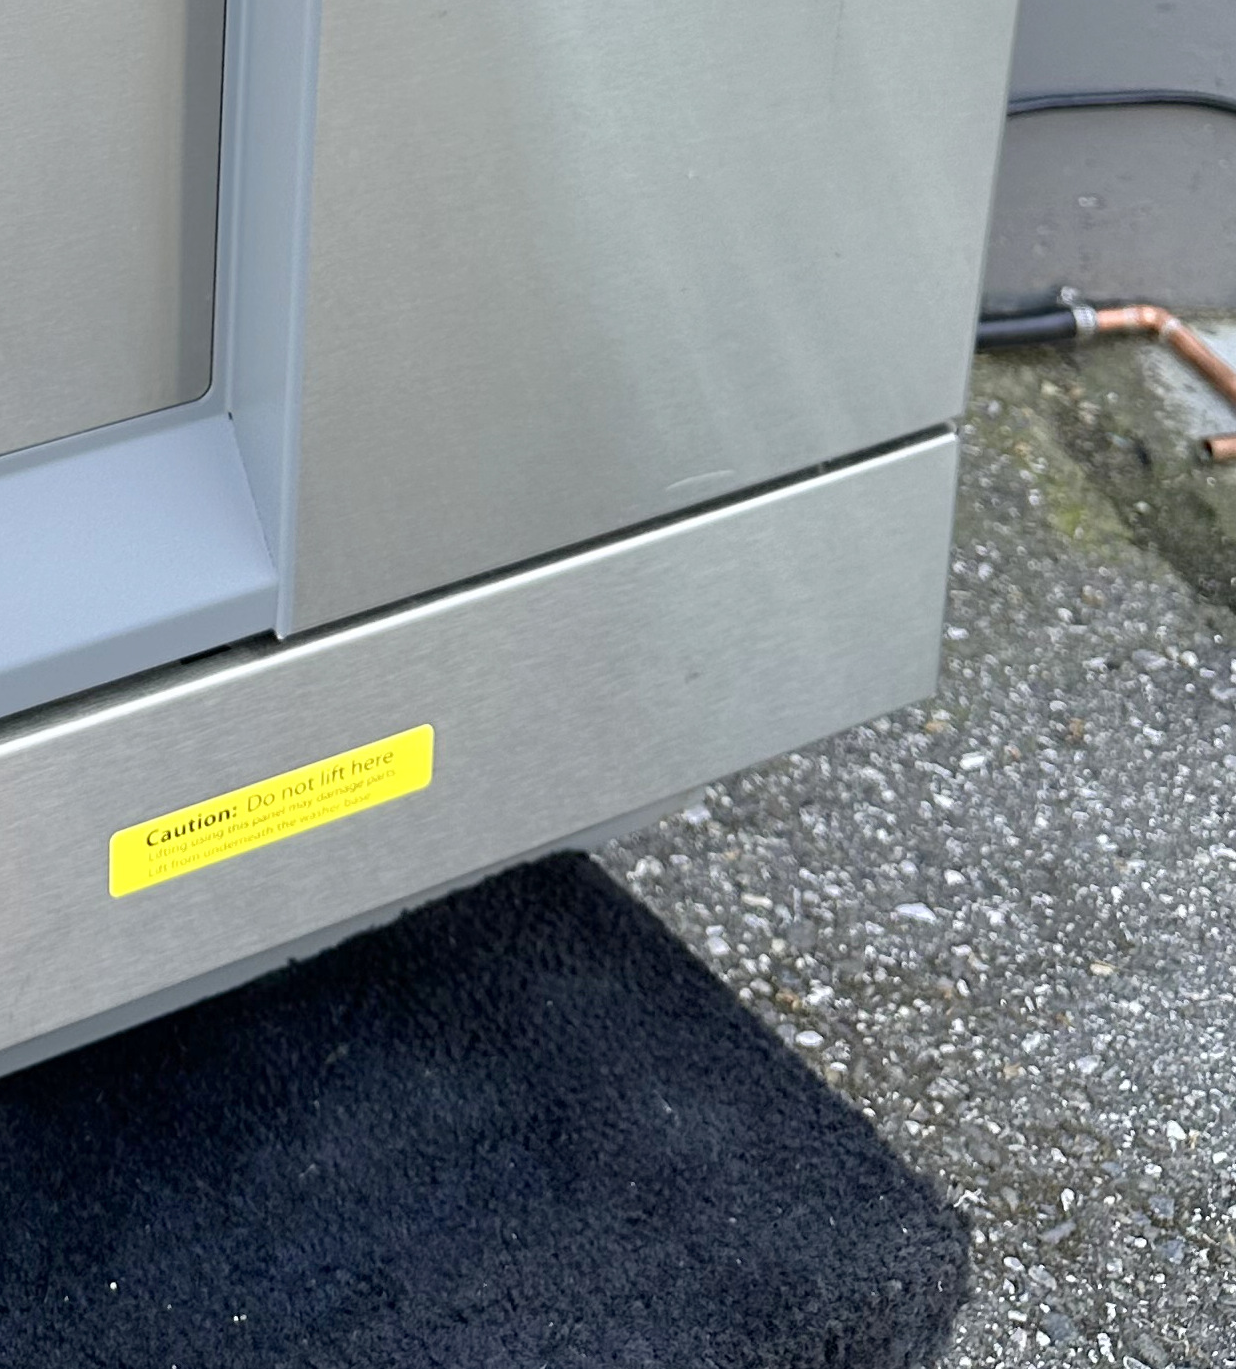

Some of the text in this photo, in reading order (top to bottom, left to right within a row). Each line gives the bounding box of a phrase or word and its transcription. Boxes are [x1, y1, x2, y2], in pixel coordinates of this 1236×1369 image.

[145, 750, 395, 847] Caution: Do not lift here
[149, 842, 188, 863] Lifting
[190, 829, 225, 849] using
[227, 819, 250, 835] this
[288, 797, 313, 814] may
[316, 779, 364, 804] damage
